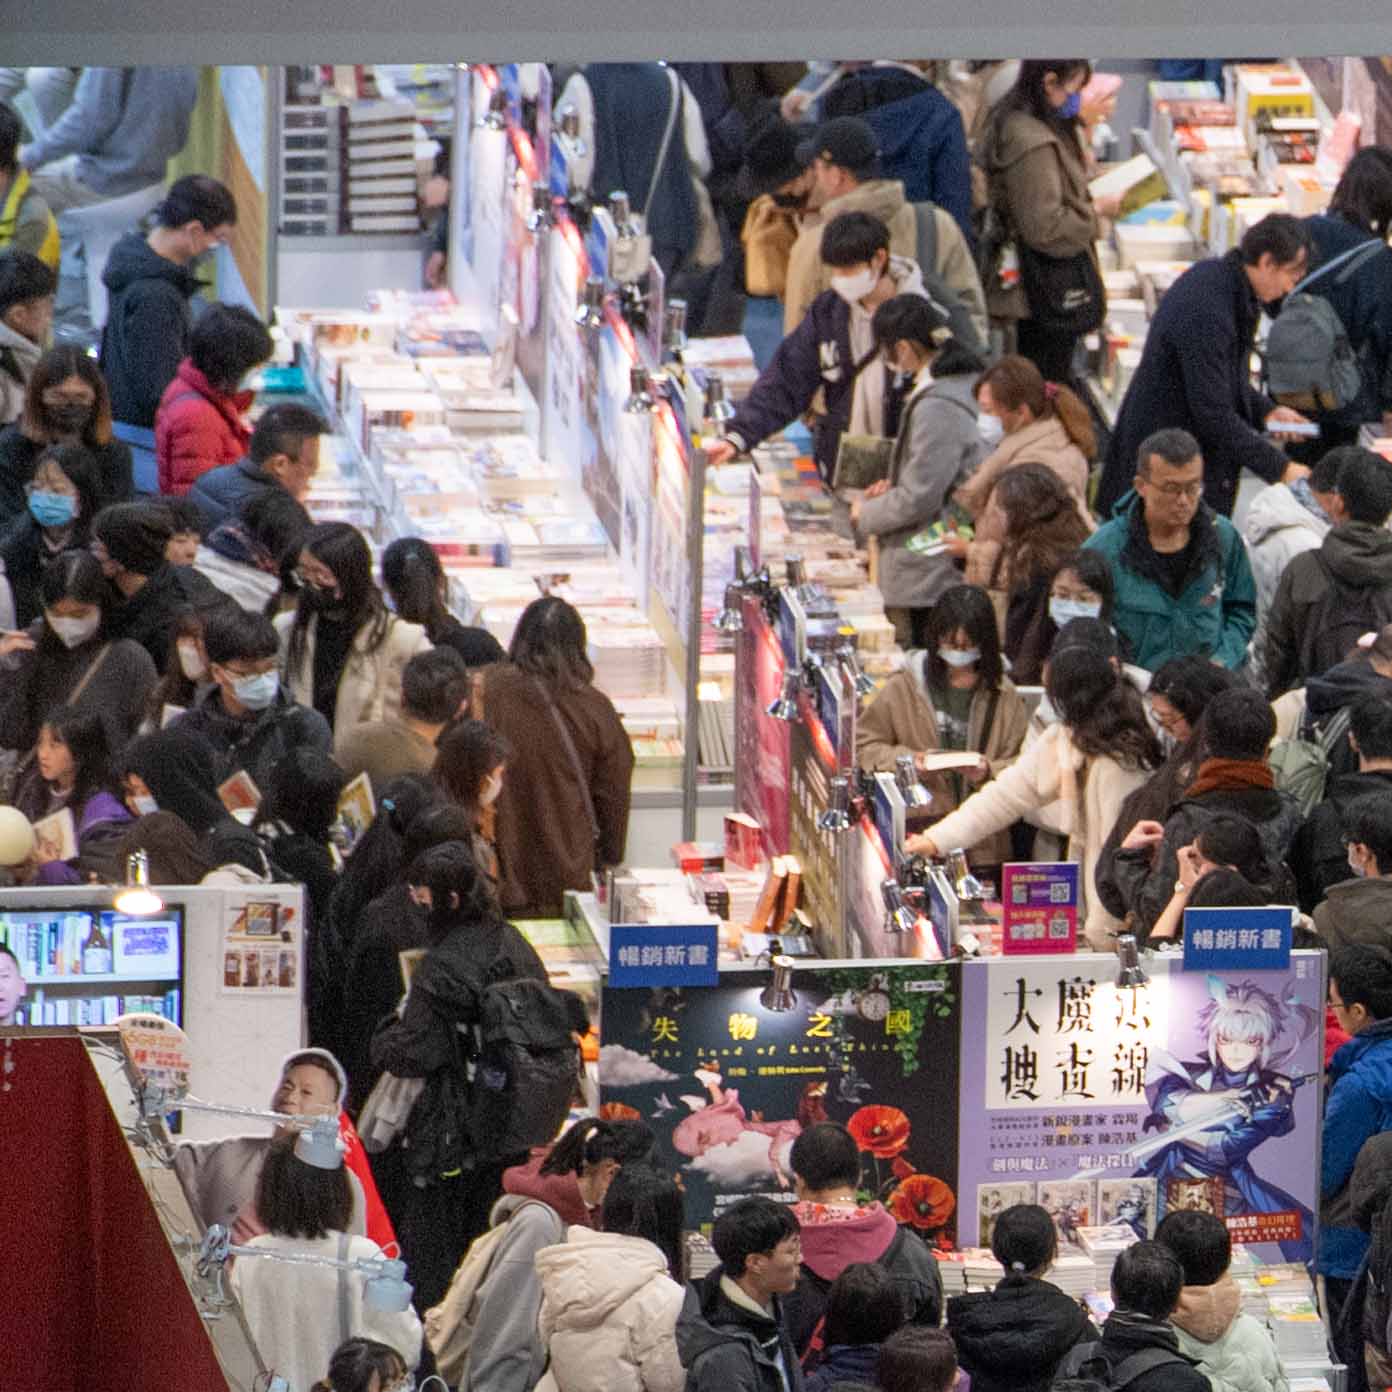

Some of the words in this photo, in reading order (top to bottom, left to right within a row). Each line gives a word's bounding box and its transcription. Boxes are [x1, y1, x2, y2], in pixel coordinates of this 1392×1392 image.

[1192, 927, 1284, 951] 暢銷新書
[618, 943, 710, 969] 暢銷新書
[652, 1009, 912, 1042] 失物之國
[697, 1046, 743, 1057] Land
